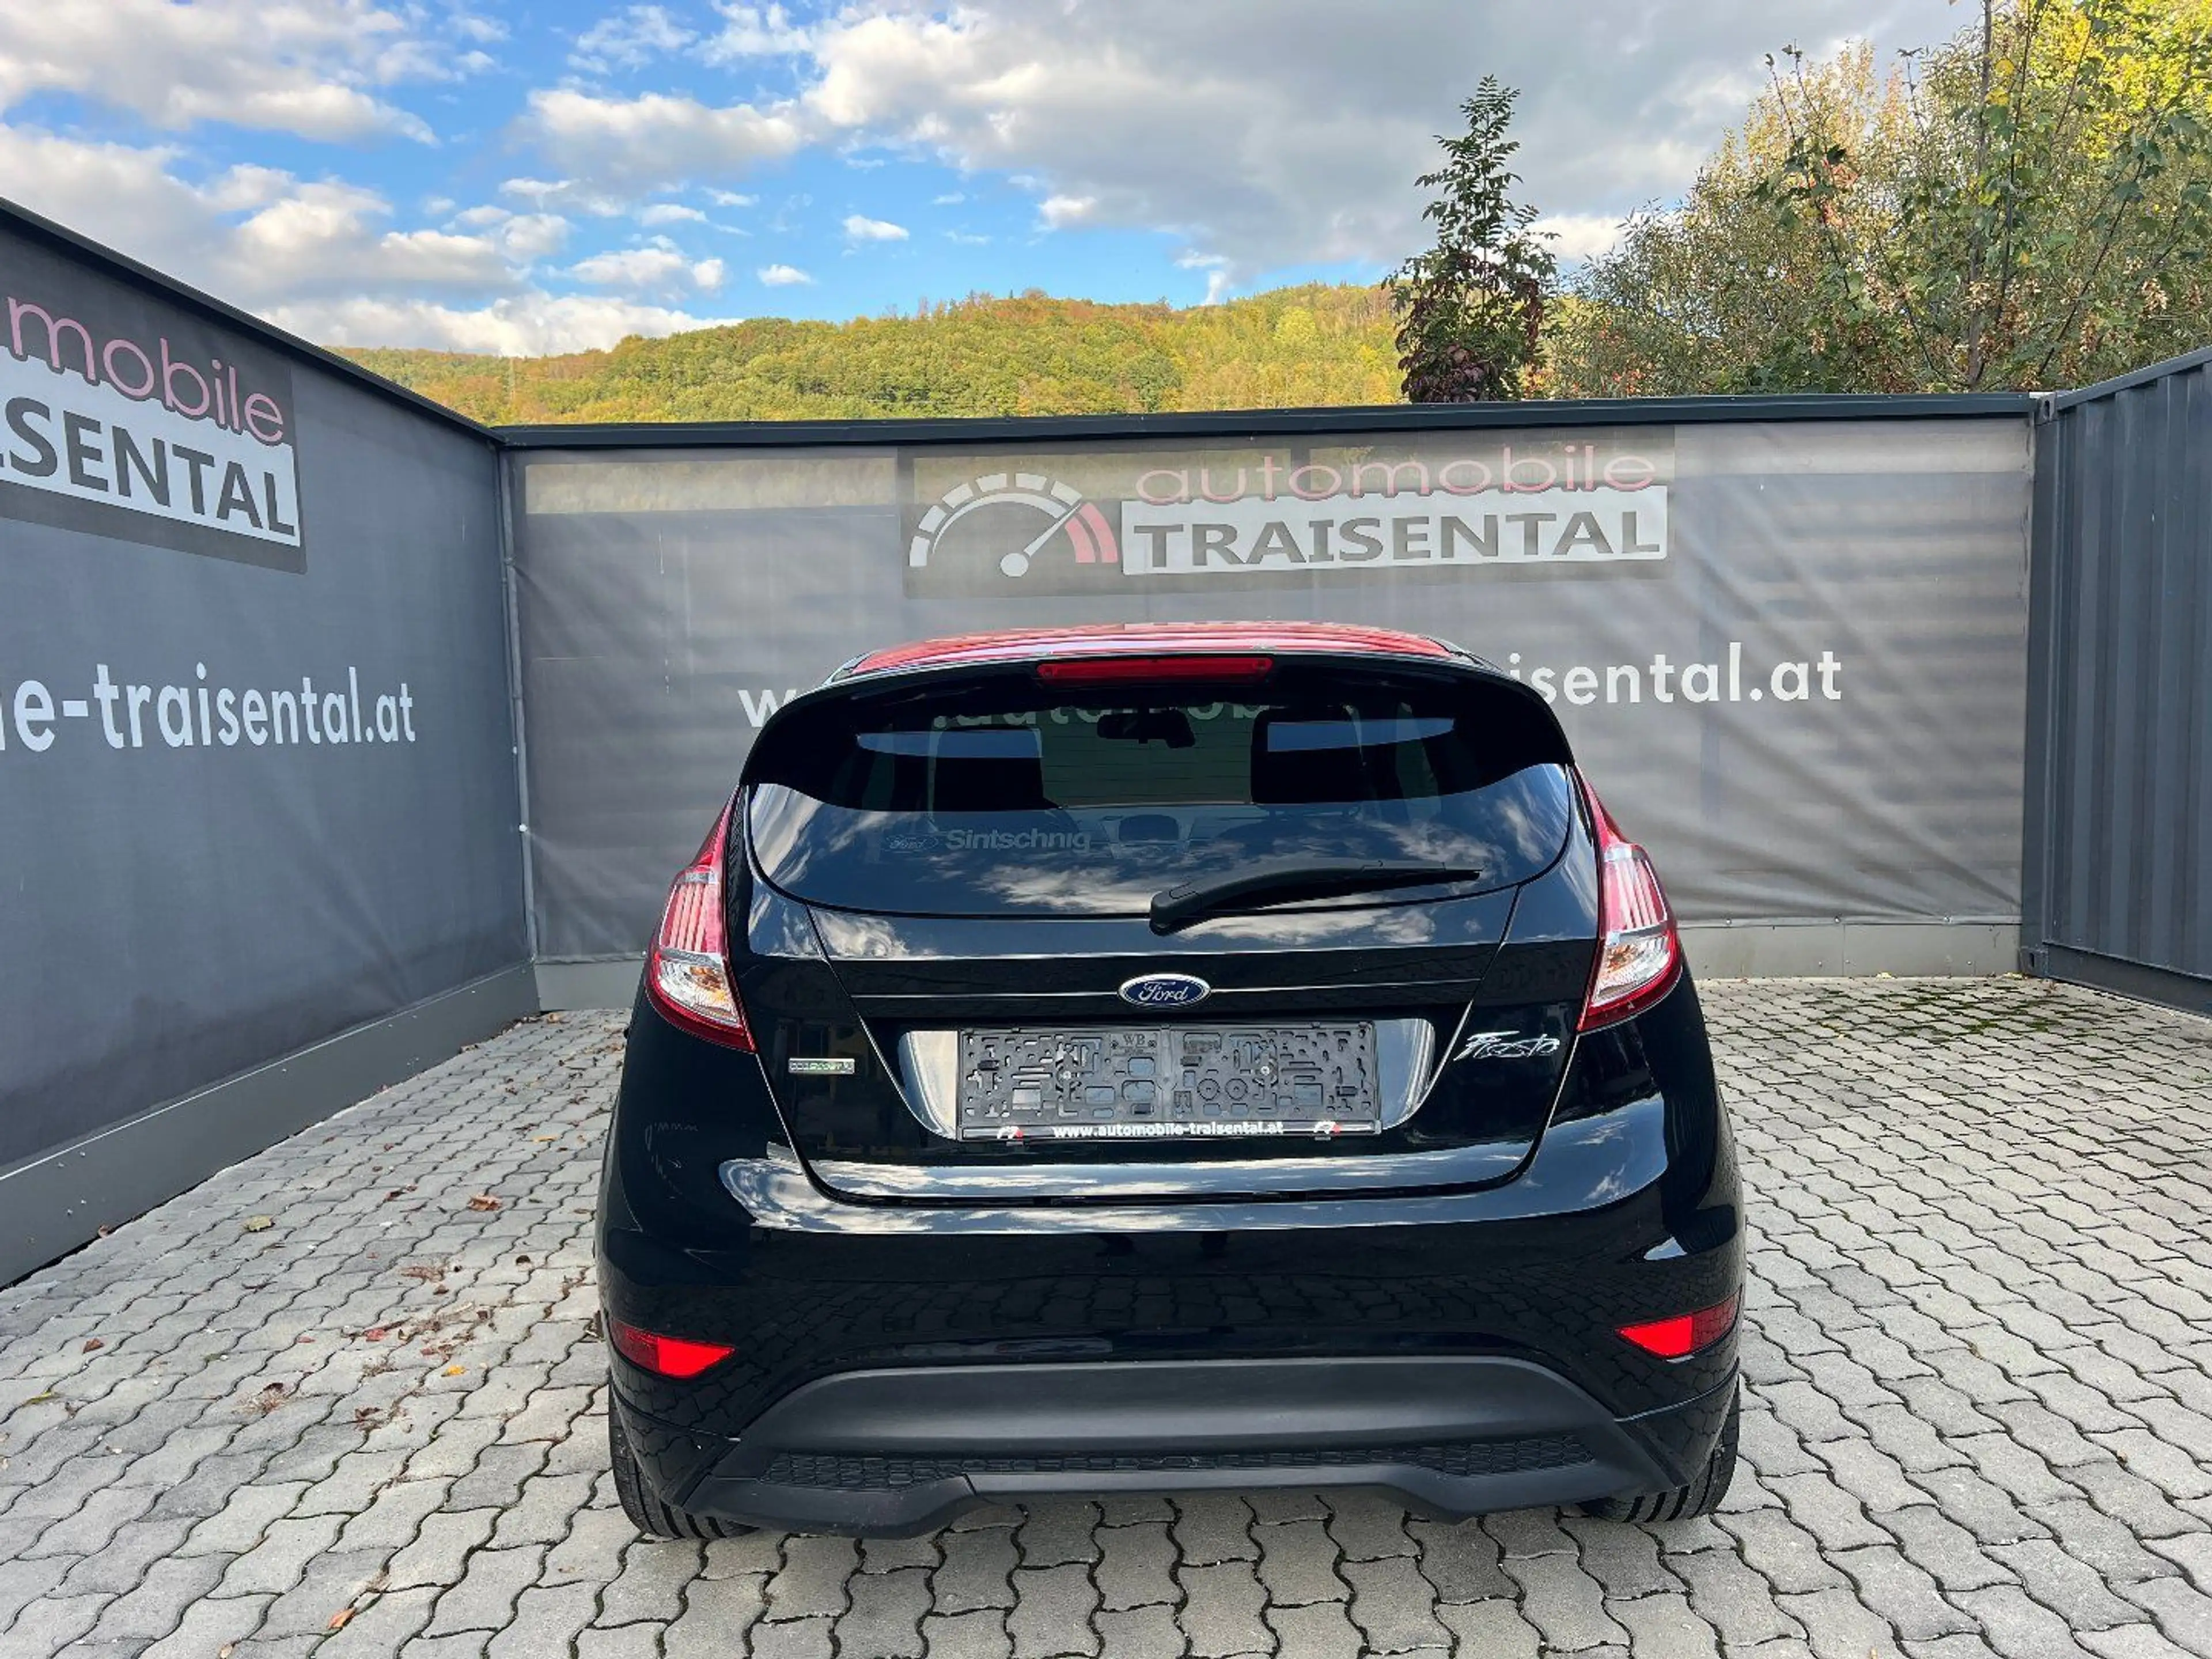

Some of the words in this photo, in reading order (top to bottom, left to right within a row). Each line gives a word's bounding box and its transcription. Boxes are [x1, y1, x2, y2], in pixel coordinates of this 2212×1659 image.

[0, 397, 296, 537] SENTAL
[1135, 445, 1656, 505] automobile
[1134, 511, 1660, 567] TRAISENTAL
[0, 662, 416, 752] e-traisental.at
[945, 828, 1091, 853] Sintschnig
[1138, 981, 1189, 1001] Ford
[1453, 1030, 1560, 1061] Fiesta
[1052, 1120, 1284, 1138] www.automobile-traisental.at
